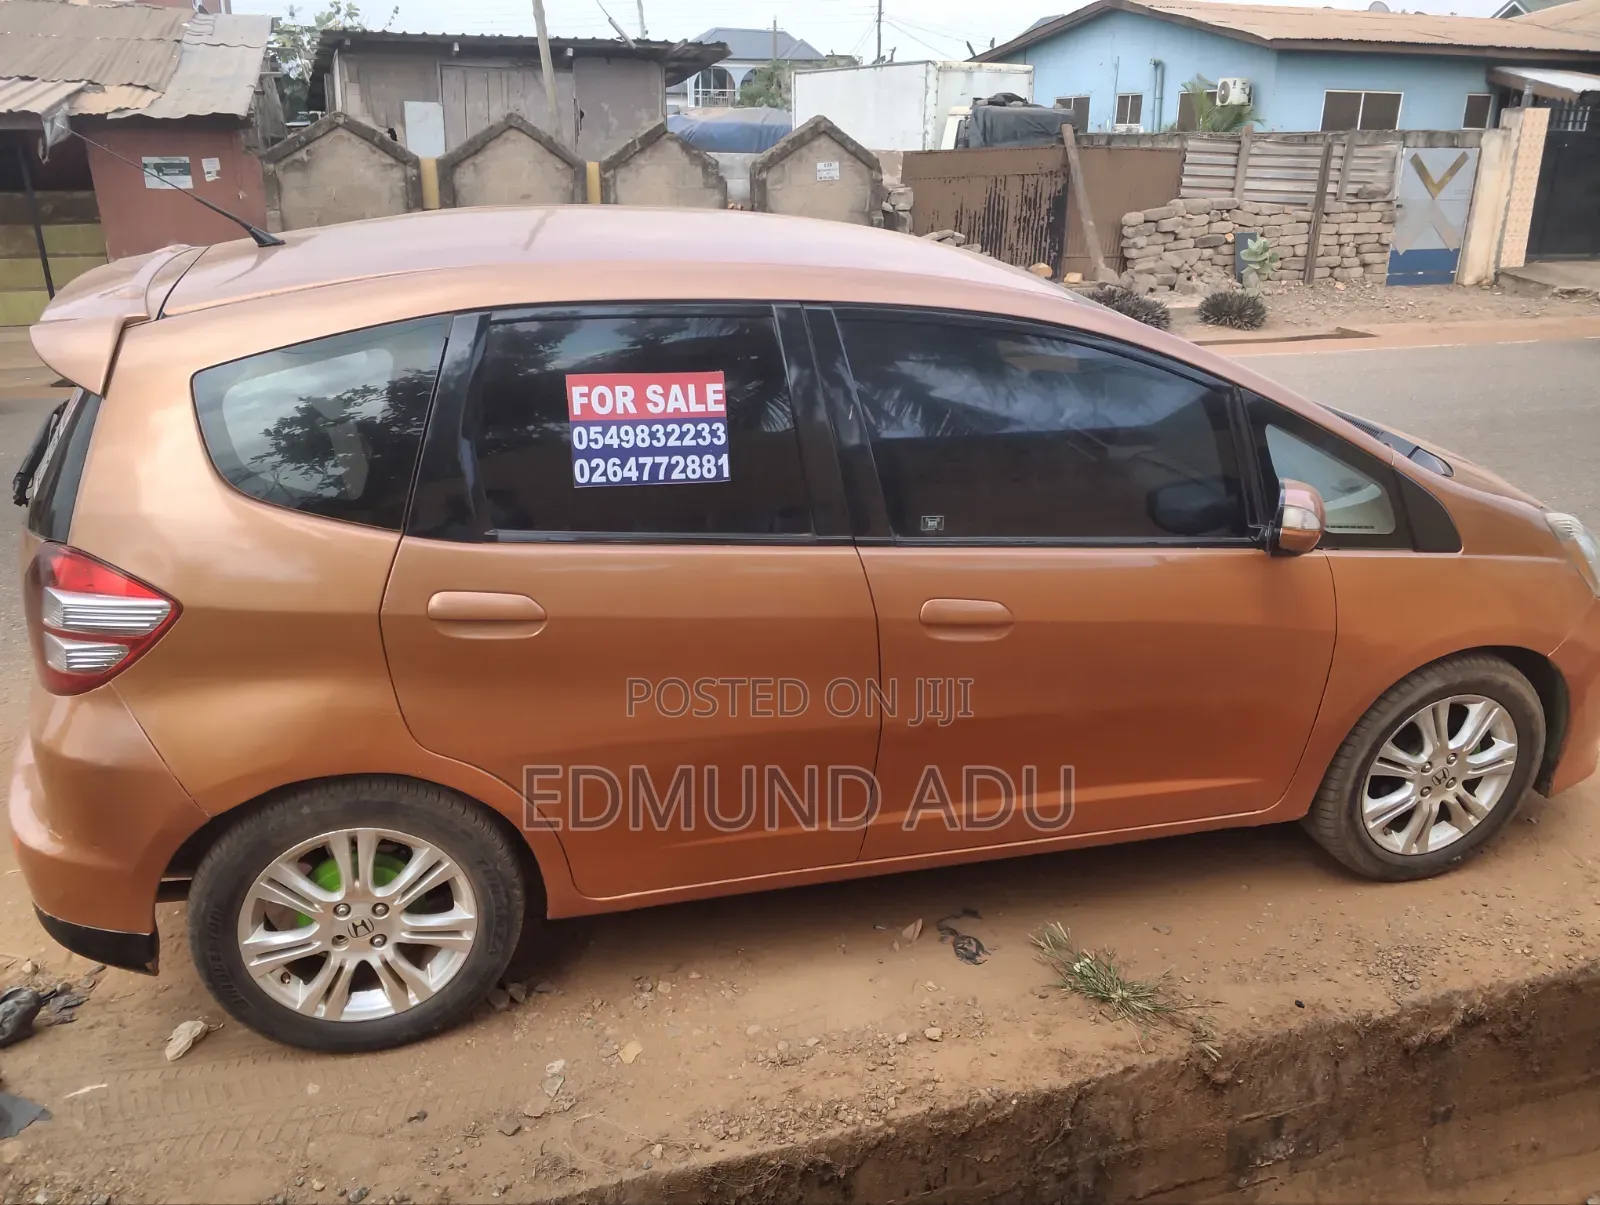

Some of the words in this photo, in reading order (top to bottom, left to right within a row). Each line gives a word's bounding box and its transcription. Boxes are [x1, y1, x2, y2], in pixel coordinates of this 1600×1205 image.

[571, 385, 637, 415] FOR
[646, 383, 725, 414] SALE
[572, 422, 727, 450] 0549832233
[574, 453, 730, 483] 0264772881
